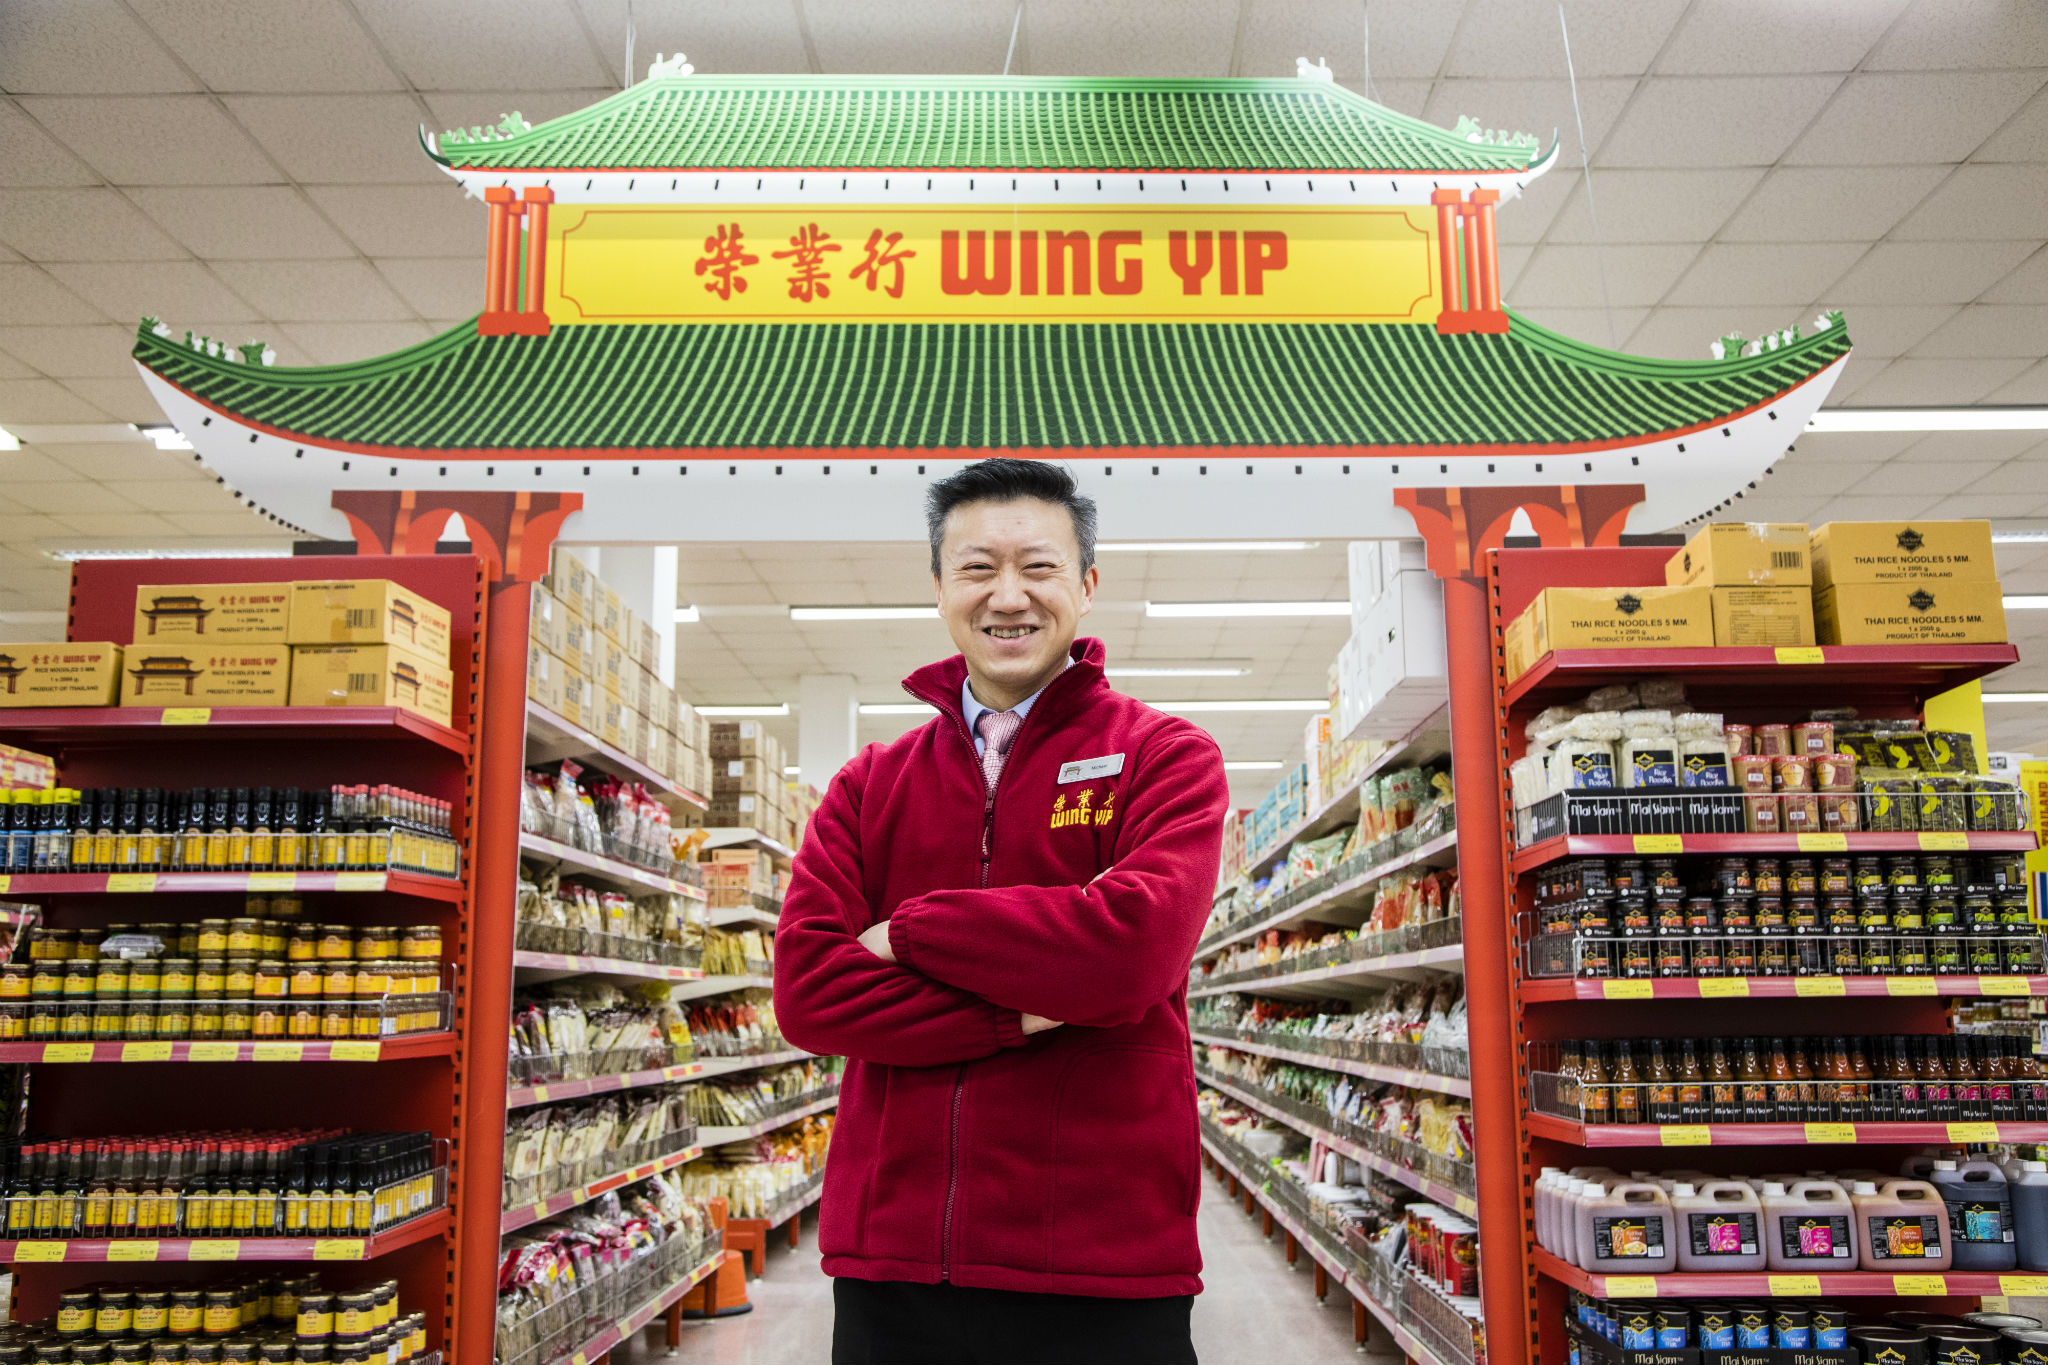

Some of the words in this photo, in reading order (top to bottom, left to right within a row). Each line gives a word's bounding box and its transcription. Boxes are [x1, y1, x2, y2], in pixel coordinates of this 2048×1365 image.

[694, 223, 916, 302] 榮業行
[940, 230, 1143, 296] WING
[1169, 230, 1288, 296] YIP
[1854, 556, 1875, 564] THAI
[1877, 556, 1898, 564] RICE
[1901, 555, 1945, 563] NOODLES
[1570, 620, 1592, 628] THAI
[1594, 619, 1615, 627] RICE
[1618, 619, 1663, 627] NOODLES
[1864, 617, 1886, 625] THAI
[1912, 616, 1957, 624] NOODLES
[1050, 808, 1091, 829] WING
[1094, 809, 1114, 826] YIP
[1635, 1353, 1653, 1365] Mai
